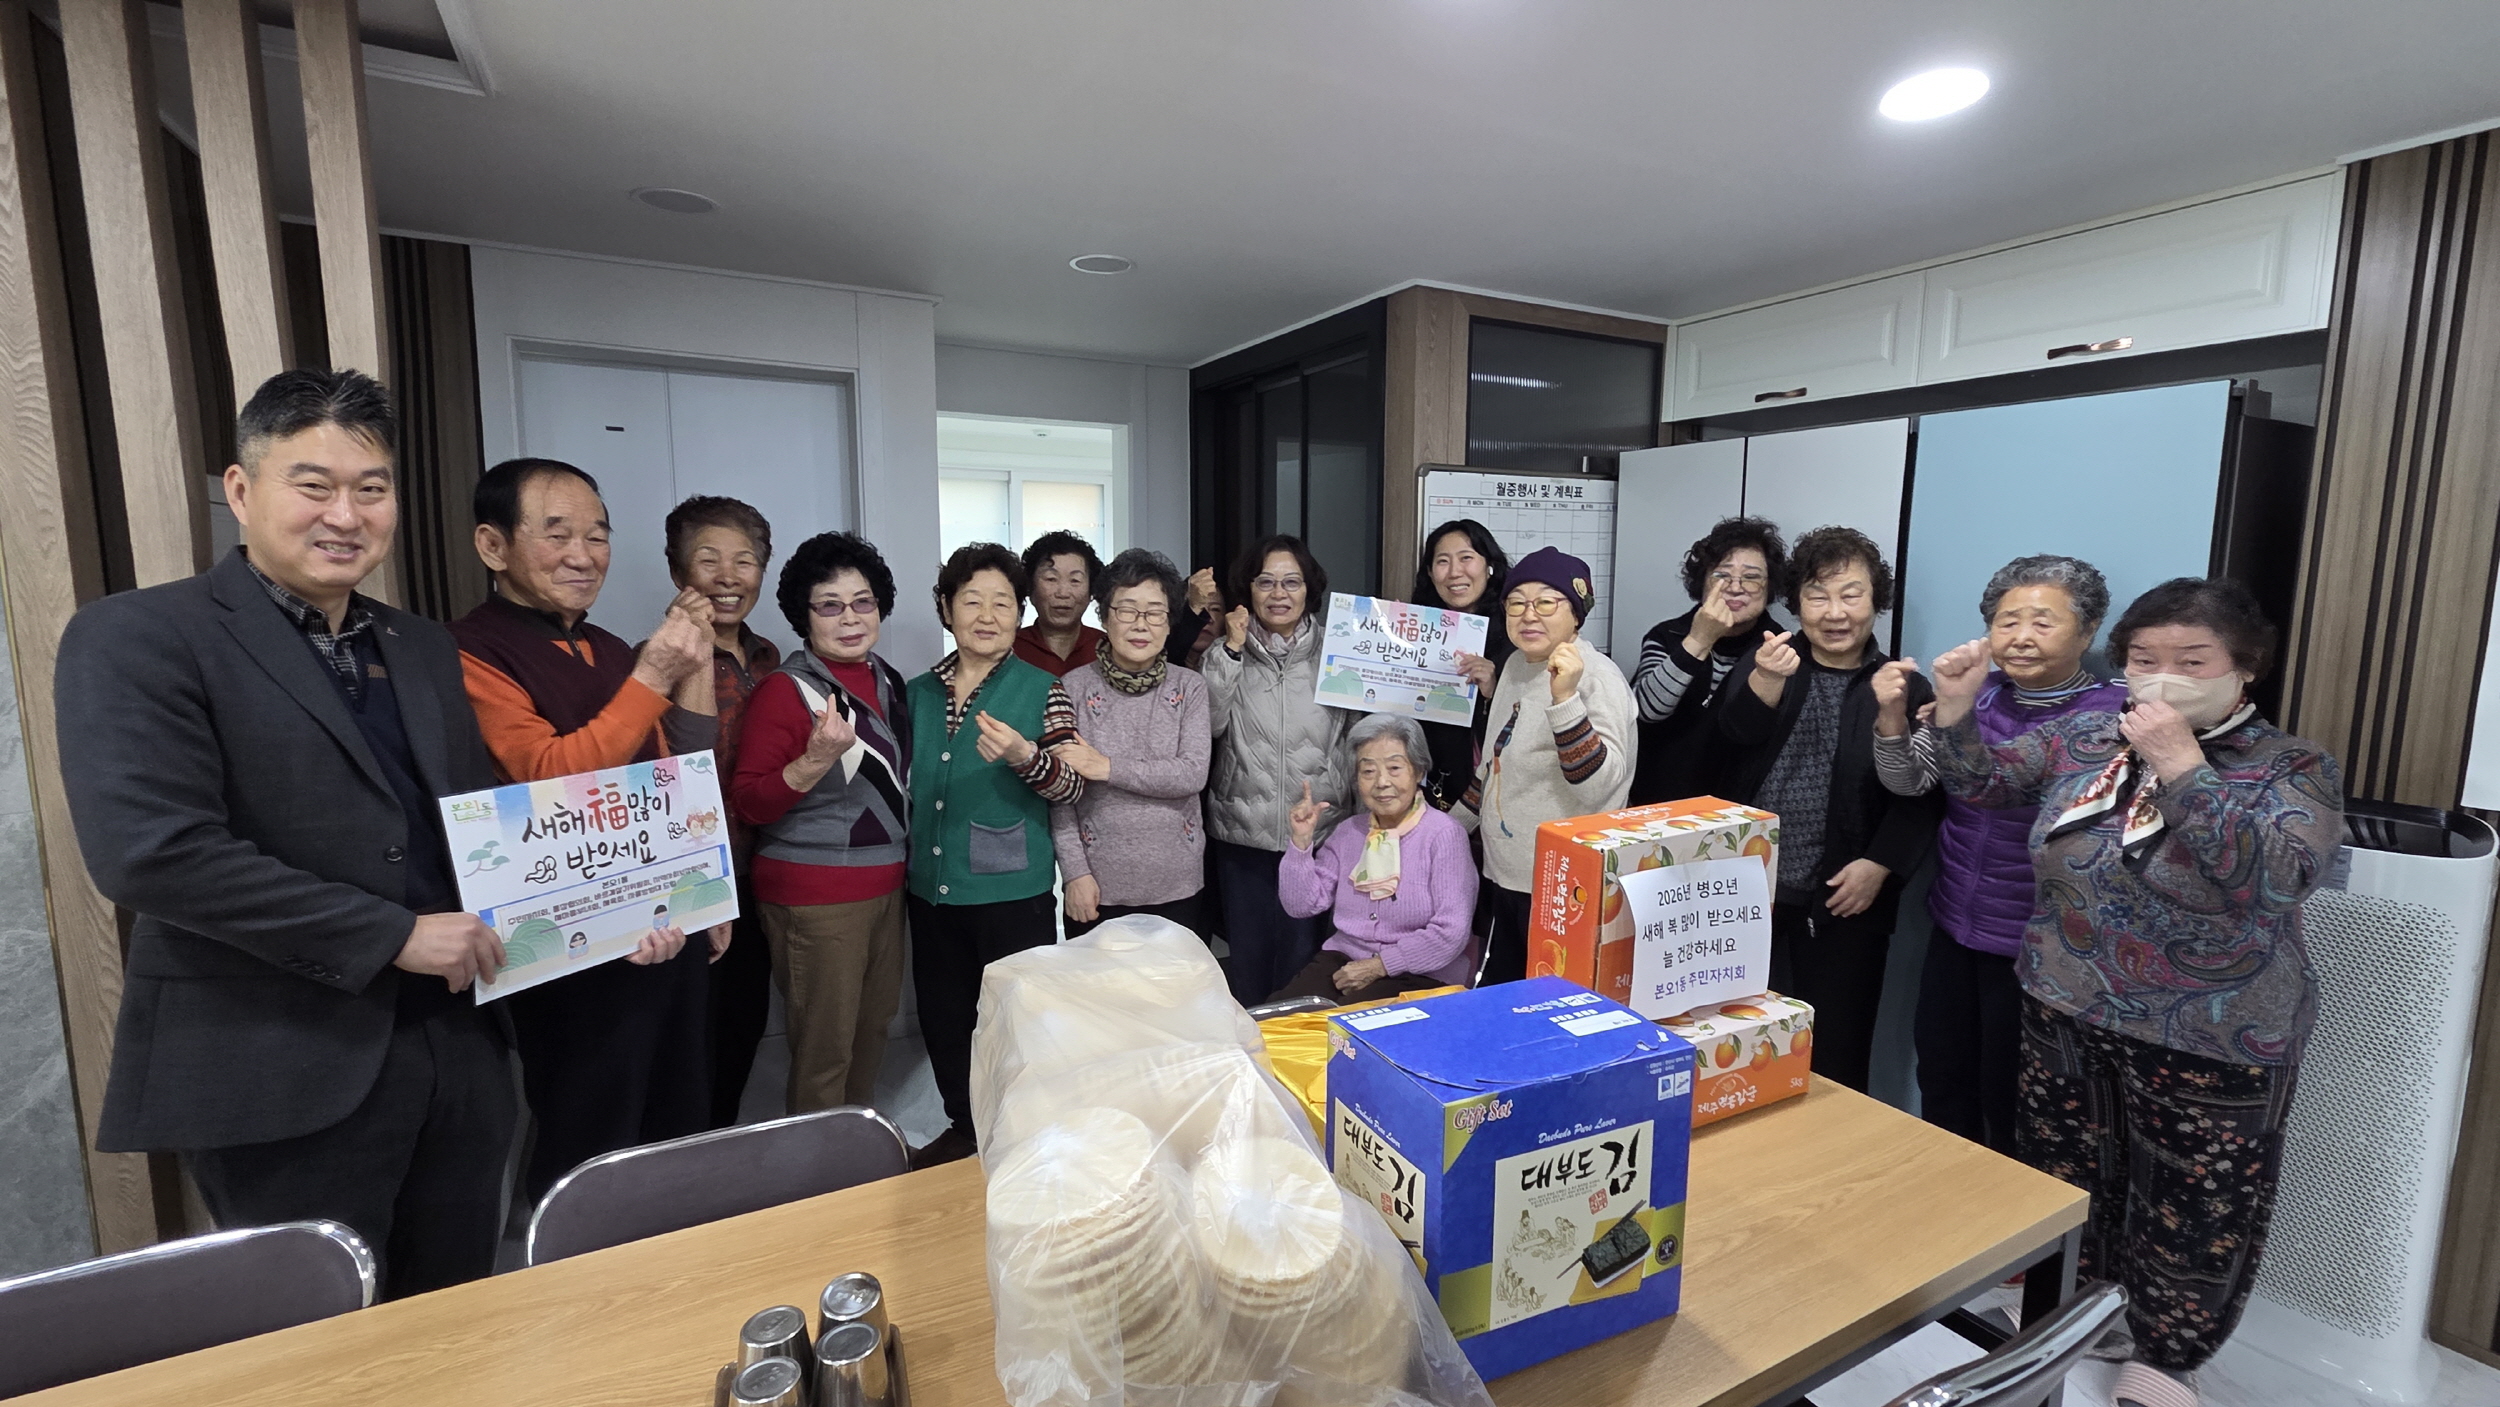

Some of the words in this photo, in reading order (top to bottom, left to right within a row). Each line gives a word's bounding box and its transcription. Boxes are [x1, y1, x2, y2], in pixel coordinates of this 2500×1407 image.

[1496, 482, 1537, 497] 월중행사
[1541, 484, 1550, 498] 및
[1554, 485, 1583, 499] 계획표
[1420, 621, 1448, 646] 많이
[1376, 641, 1428, 668] 받으세요
[522, 802, 585, 843] 새해
[587, 782, 629, 833] 福
[627, 785, 670, 822] 많이
[566, 830, 657, 880] 받으세요
[1658, 883, 1691, 906] 2026년
[1697, 877, 1738, 899] 병오년
[1642, 920, 1664, 942] 새해
[1668, 917, 1678, 936] 복
[1681, 910, 1699, 932] 많이
[1707, 905, 1763, 927] 받으세요
[1663, 951, 1674, 969] 늘
[1677, 938, 1737, 964] 건강하세요
[1654, 976, 1687, 1000] 본오1동
[1689, 965, 1746, 988] 주민자치회
[1329, 1030, 1344, 1051] Gift
[1343, 1040, 1356, 1060] Set
[1453, 1102, 1487, 1134] Gift
[1487, 1099, 1514, 1122] Set
[1538, 1129, 1571, 1144] Daebudo
[1574, 1123, 1593, 1136] Pure
[1594, 1117, 1617, 1130] Laver
[1344, 1115, 1386, 1172] 대부도
[1388, 1155, 1417, 1224] 김
[1521, 1147, 1596, 1191] 대부도
[1600, 1128, 1641, 1197] 김
